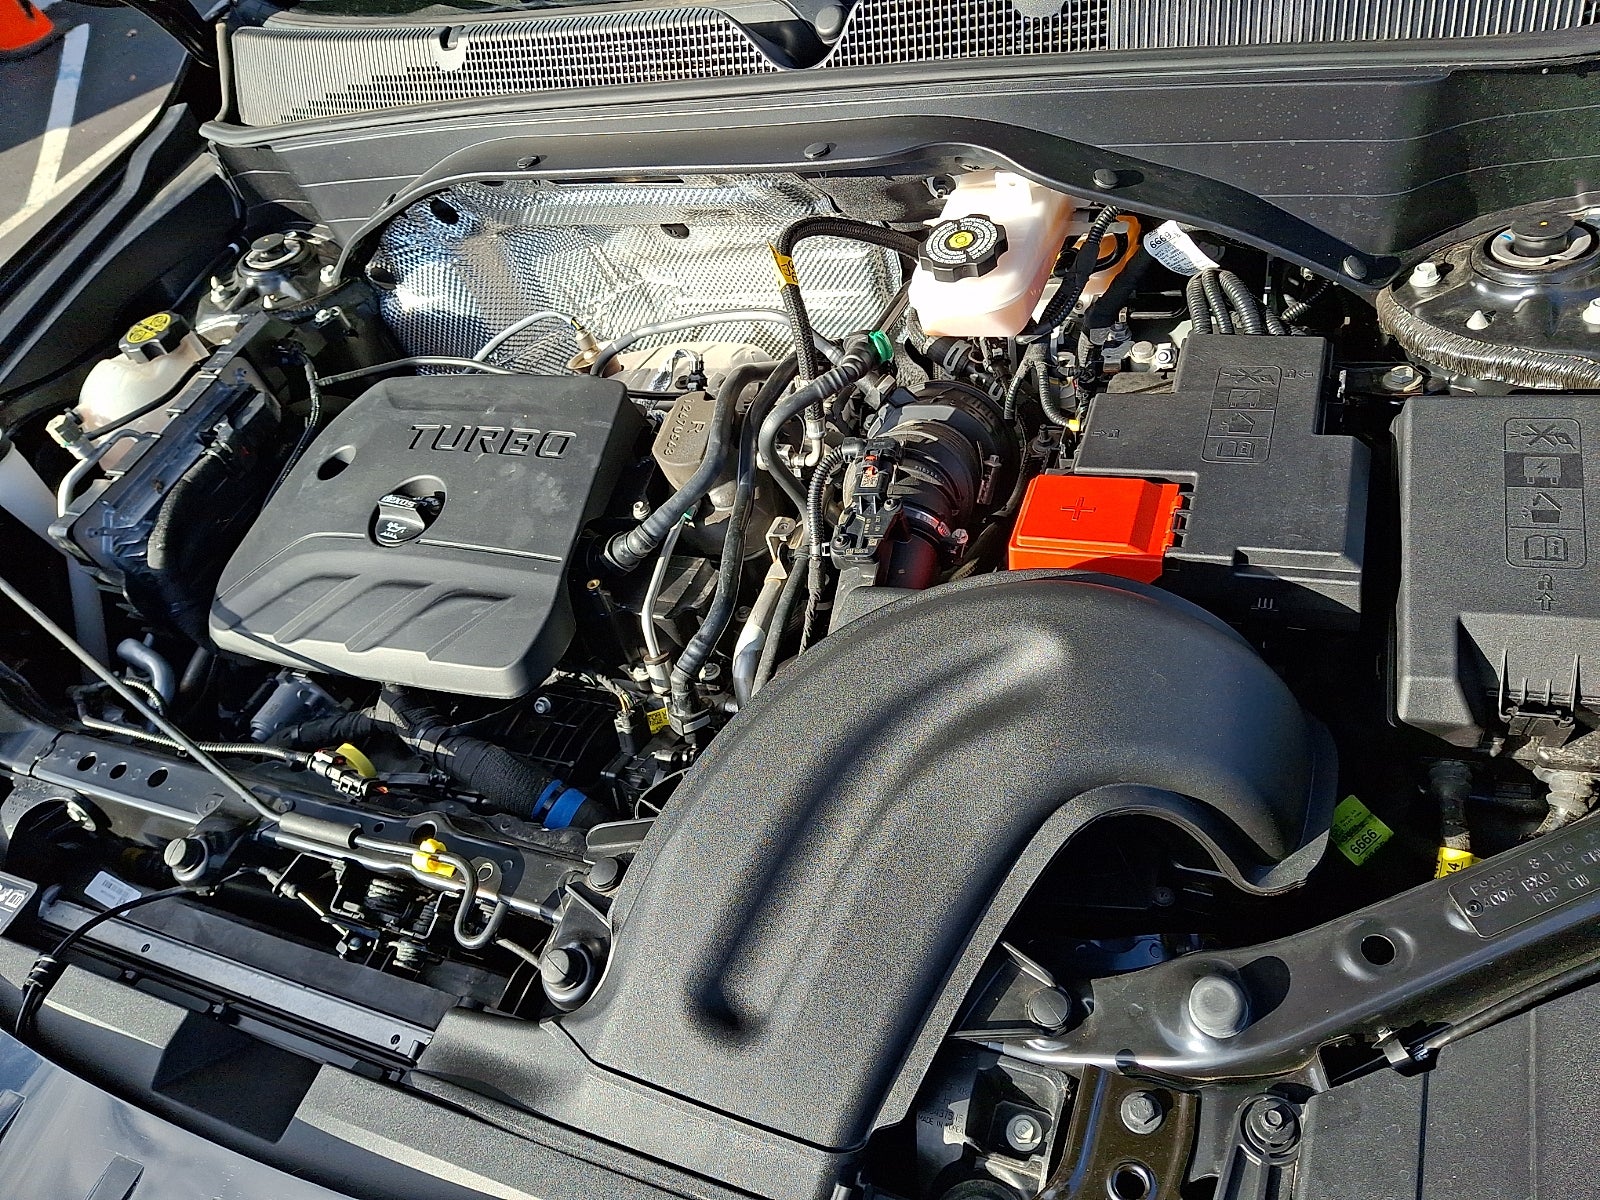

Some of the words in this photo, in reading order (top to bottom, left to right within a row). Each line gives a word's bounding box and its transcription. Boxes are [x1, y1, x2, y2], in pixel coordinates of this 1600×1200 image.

[687, 420, 705, 433] R
[409, 425, 576, 459] TURBO
[1350, 828, 1377, 854] 6666
